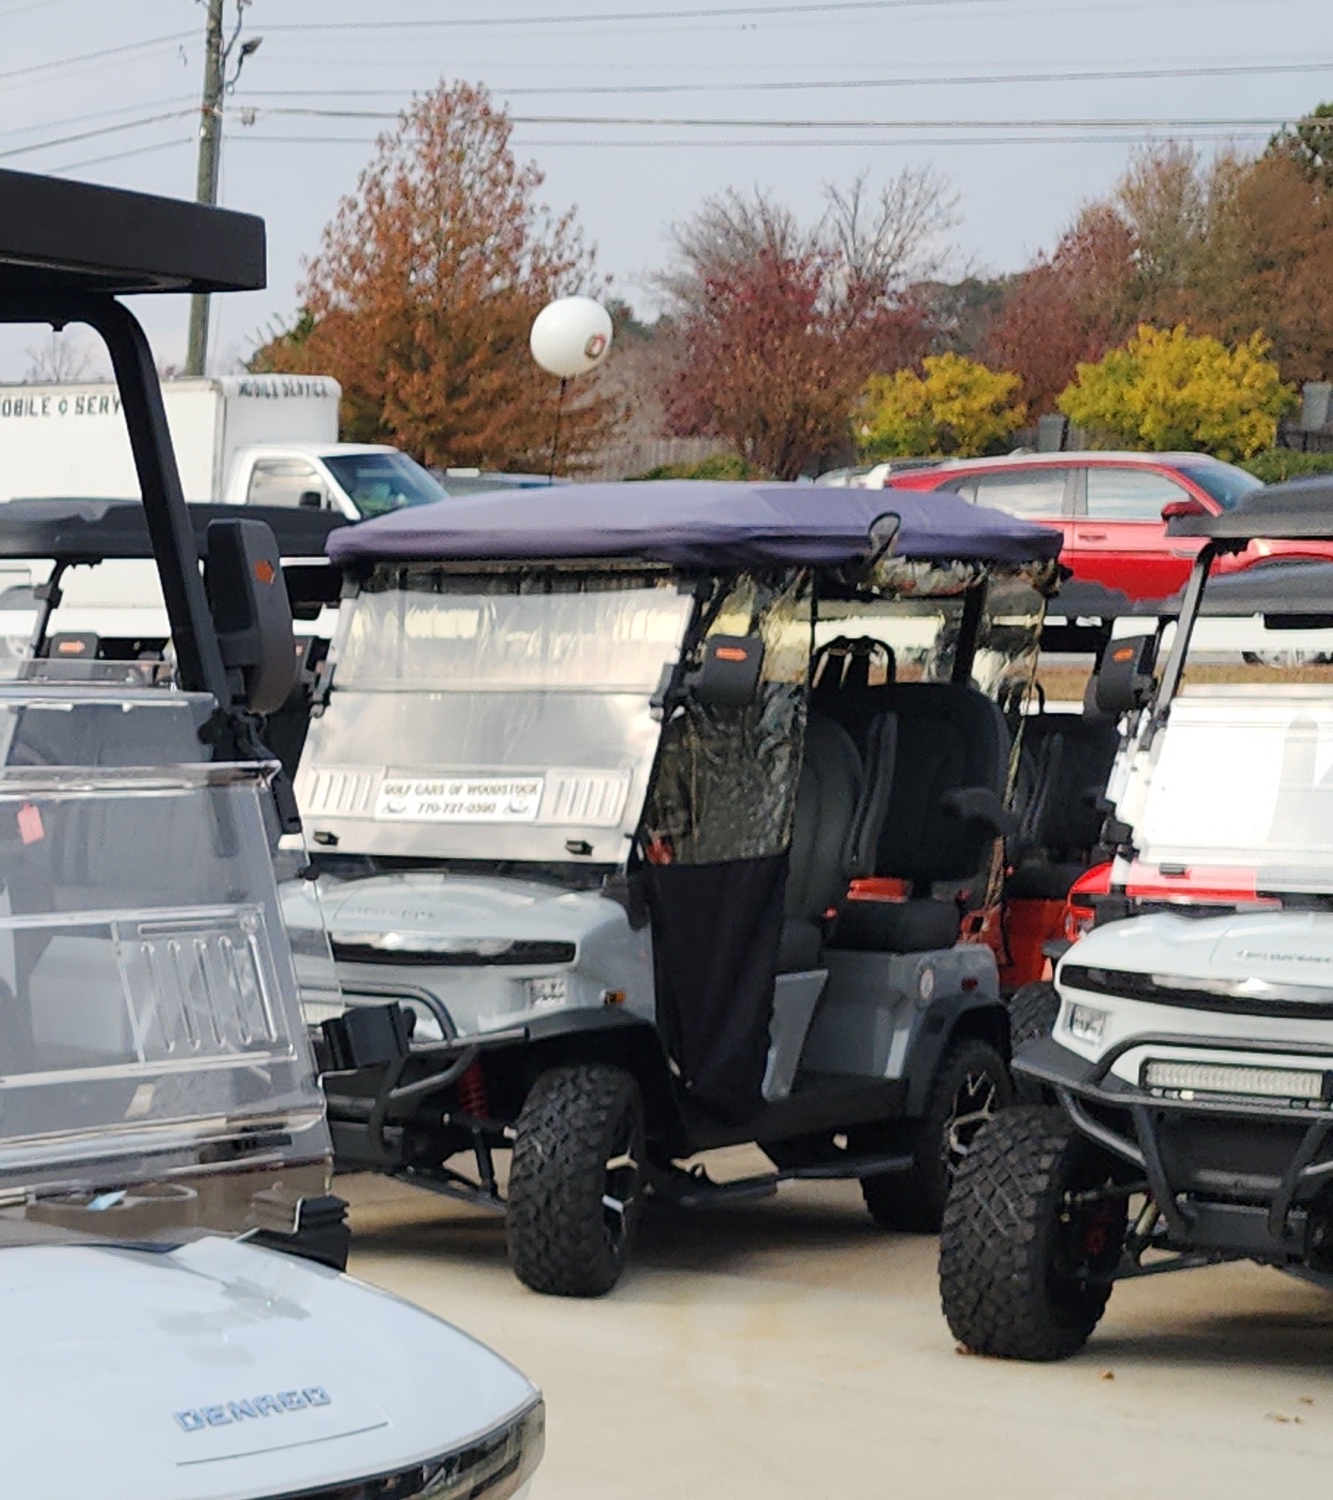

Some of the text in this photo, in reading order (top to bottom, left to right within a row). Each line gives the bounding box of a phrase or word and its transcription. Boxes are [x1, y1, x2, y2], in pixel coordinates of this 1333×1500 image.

[74, 395, 121, 415] SERV
[449, 783, 463, 796] OF
[174, 1385, 332, 1432] DENAGO
